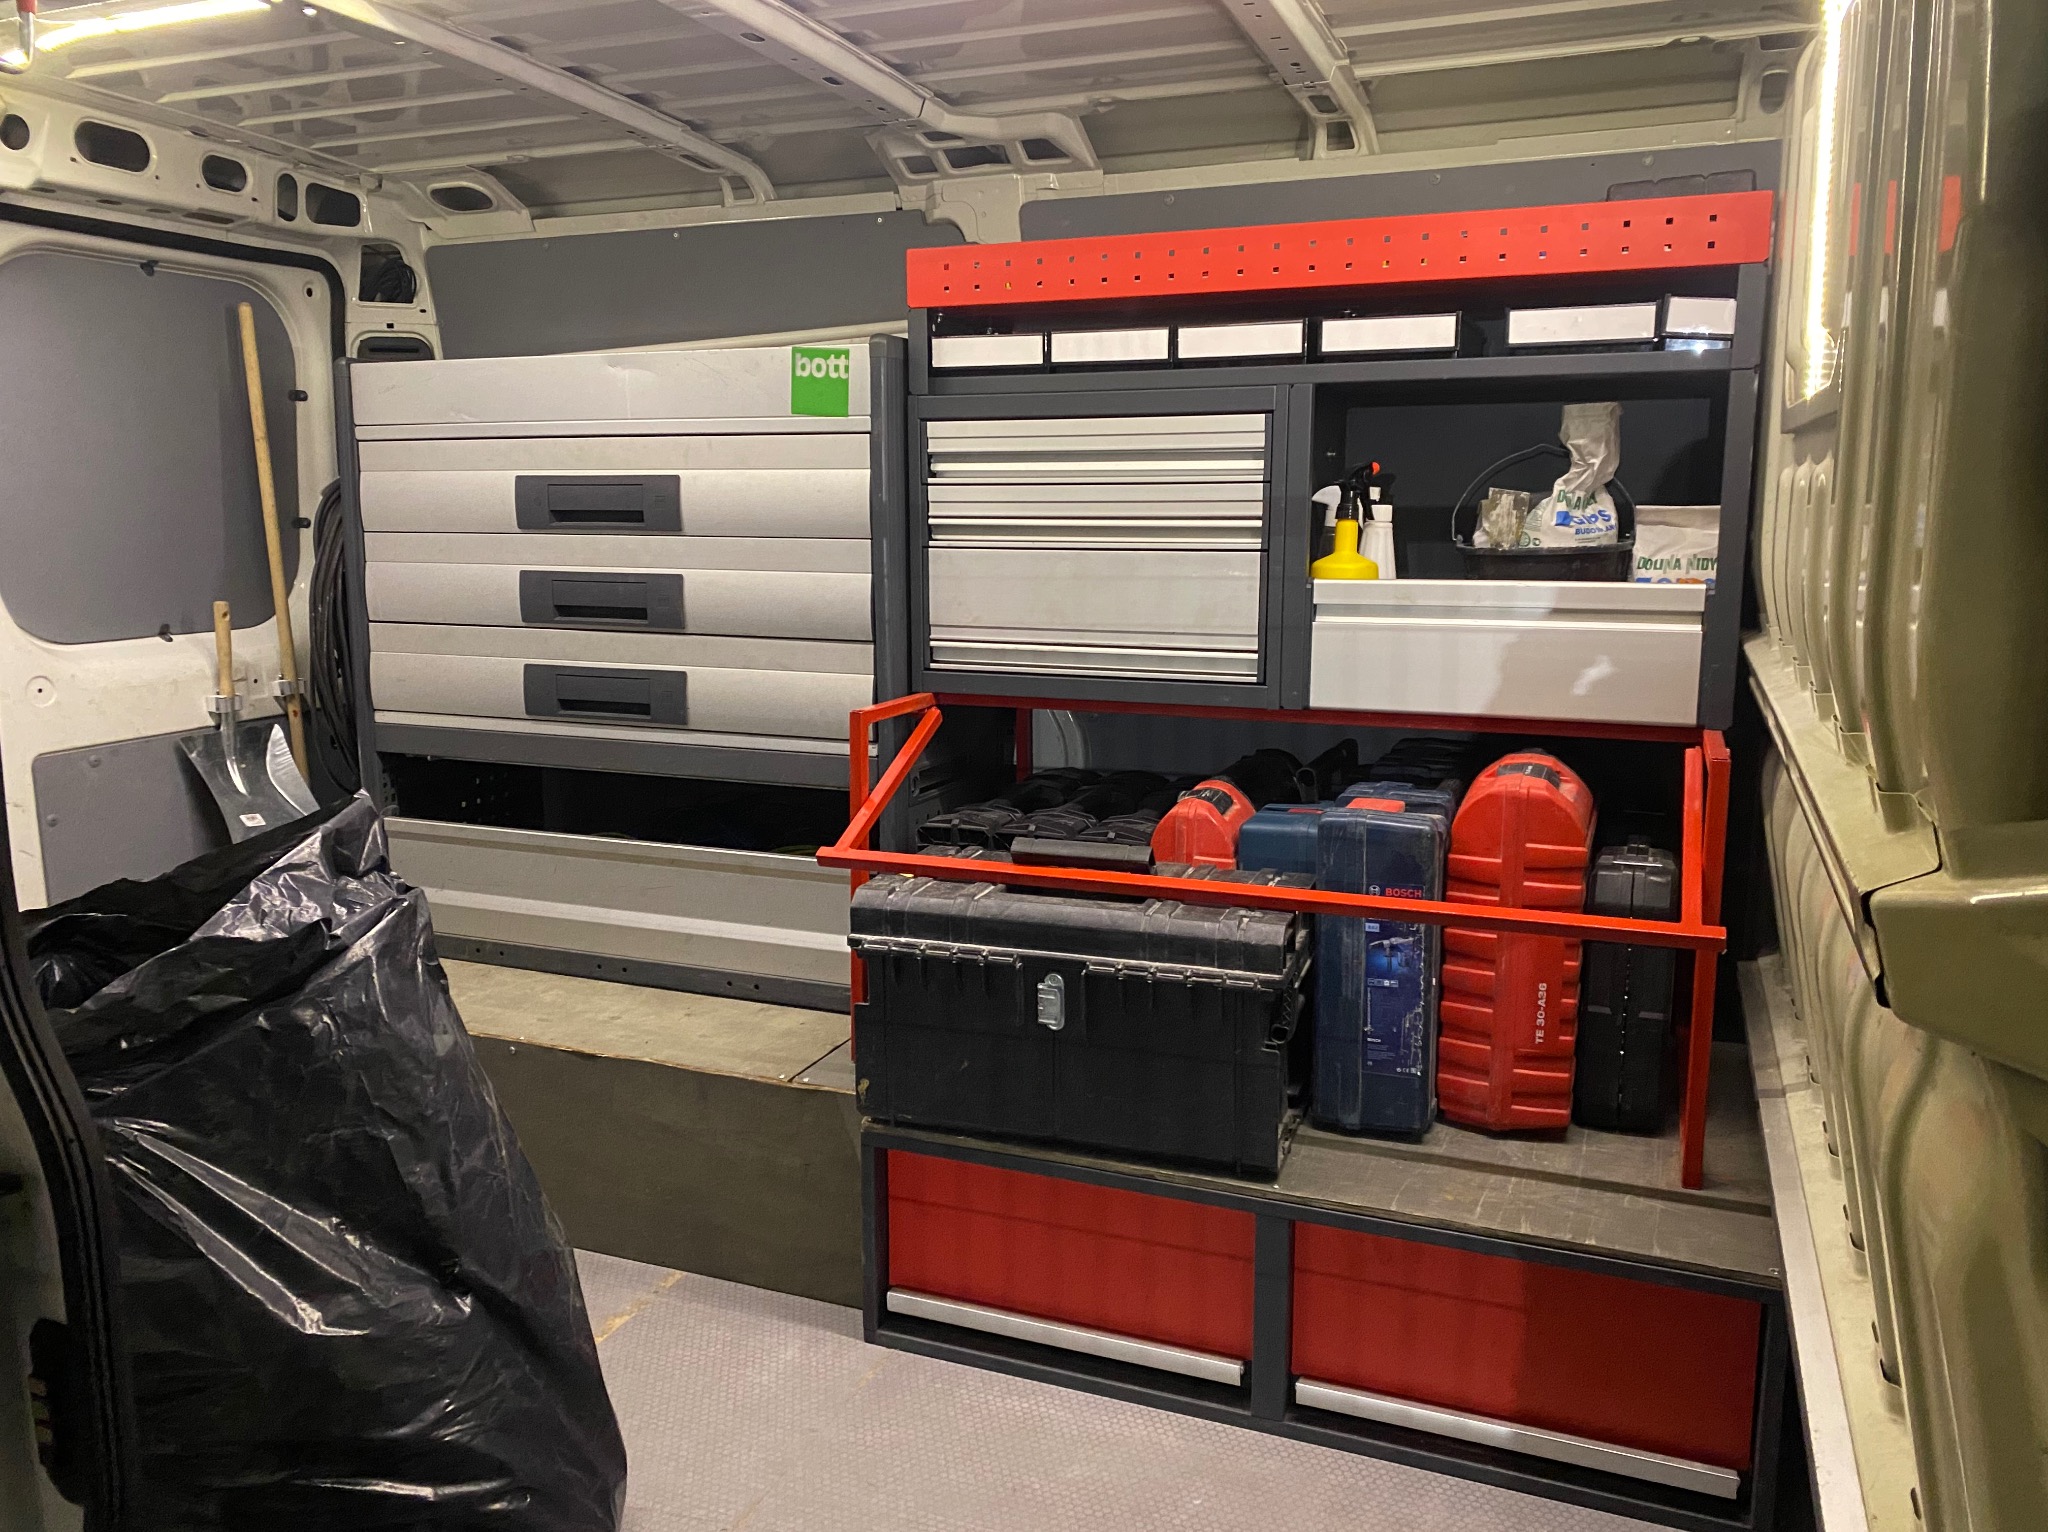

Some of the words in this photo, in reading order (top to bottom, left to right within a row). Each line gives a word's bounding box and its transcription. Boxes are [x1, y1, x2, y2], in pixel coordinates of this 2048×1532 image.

[795, 352, 849, 379] bott
[1636, 554, 1682, 574] DOLINA
[1385, 887, 1423, 898] BOSCH
[1535, 1029, 1545, 1045] TE
